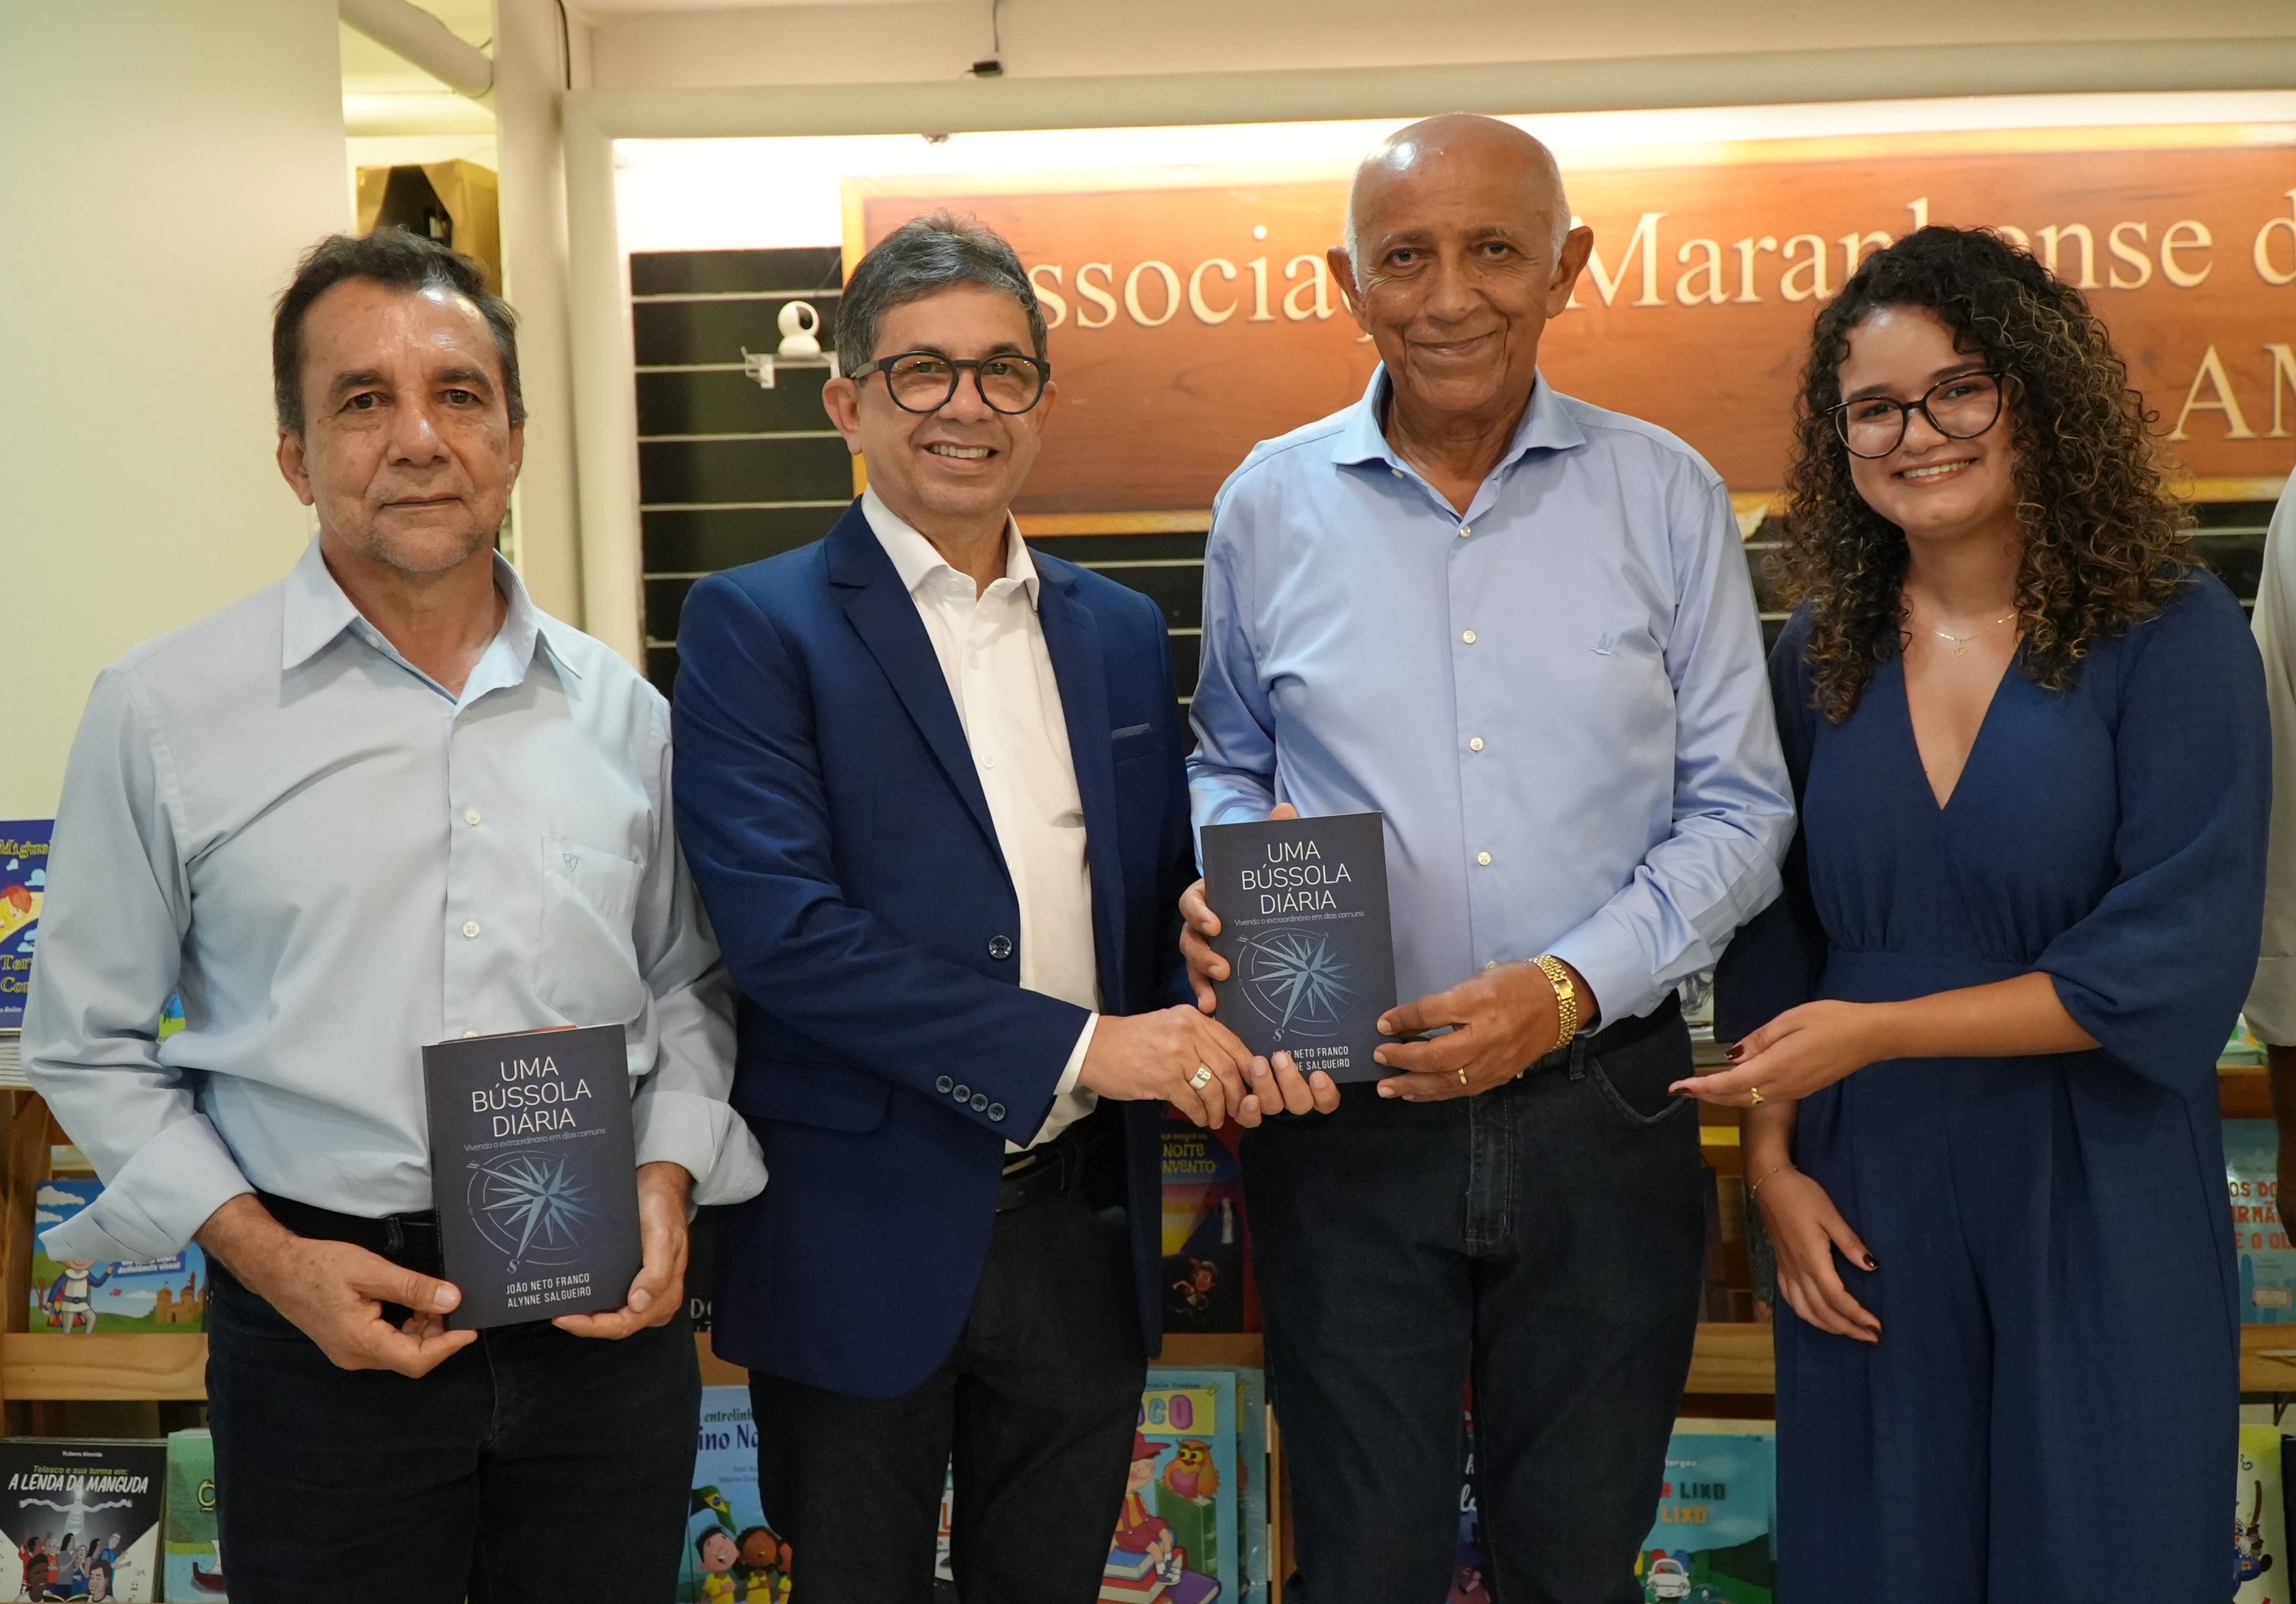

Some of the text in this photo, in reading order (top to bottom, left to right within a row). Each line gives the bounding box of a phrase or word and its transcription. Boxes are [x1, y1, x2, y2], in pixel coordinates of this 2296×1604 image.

[1027, 224, 1373, 343] ssocia
[1568, 196, 2213, 309] Maranse
[0, 839, 51, 860] Migue
[1267, 840, 1321, 863] UMA
[1241, 863, 1351, 890] BÚSSOLA
[1261, 887, 1337, 915] DIÁRIA
[1235, 918, 1259, 926] Vivendo
[1338, 910, 1364, 919] comuns
[1294, 1048, 1315, 1059] NETO
[1317, 1046, 1348, 1057] FRANCO
[1306, 1058, 1350, 1070] SALGUEIRO
[501, 1056, 559, 1082] UMA
[472, 1078, 592, 1112] BÚSSOLA
[493, 1107, 577, 1138] DIÁRIA
[463, 1142, 492, 1152] Vivendo
[562, 1132, 577, 1140] dias
[577, 1128, 606, 1138] comuns
[1162, 1160, 1217, 1174] NVENTO
[2231, 1200, 2282, 1224] IRMÃ
[506, 1272, 590, 1295] JOÃO NETO FRANCO
[507, 1285, 591, 1308] ALYNNE SALGUEIRO
[8, 1473, 149, 1494] A LENDA DA MANGUDA
[1679, 1482, 1726, 1500] LIXO
[1660, 1504, 1708, 1524] LIXO
